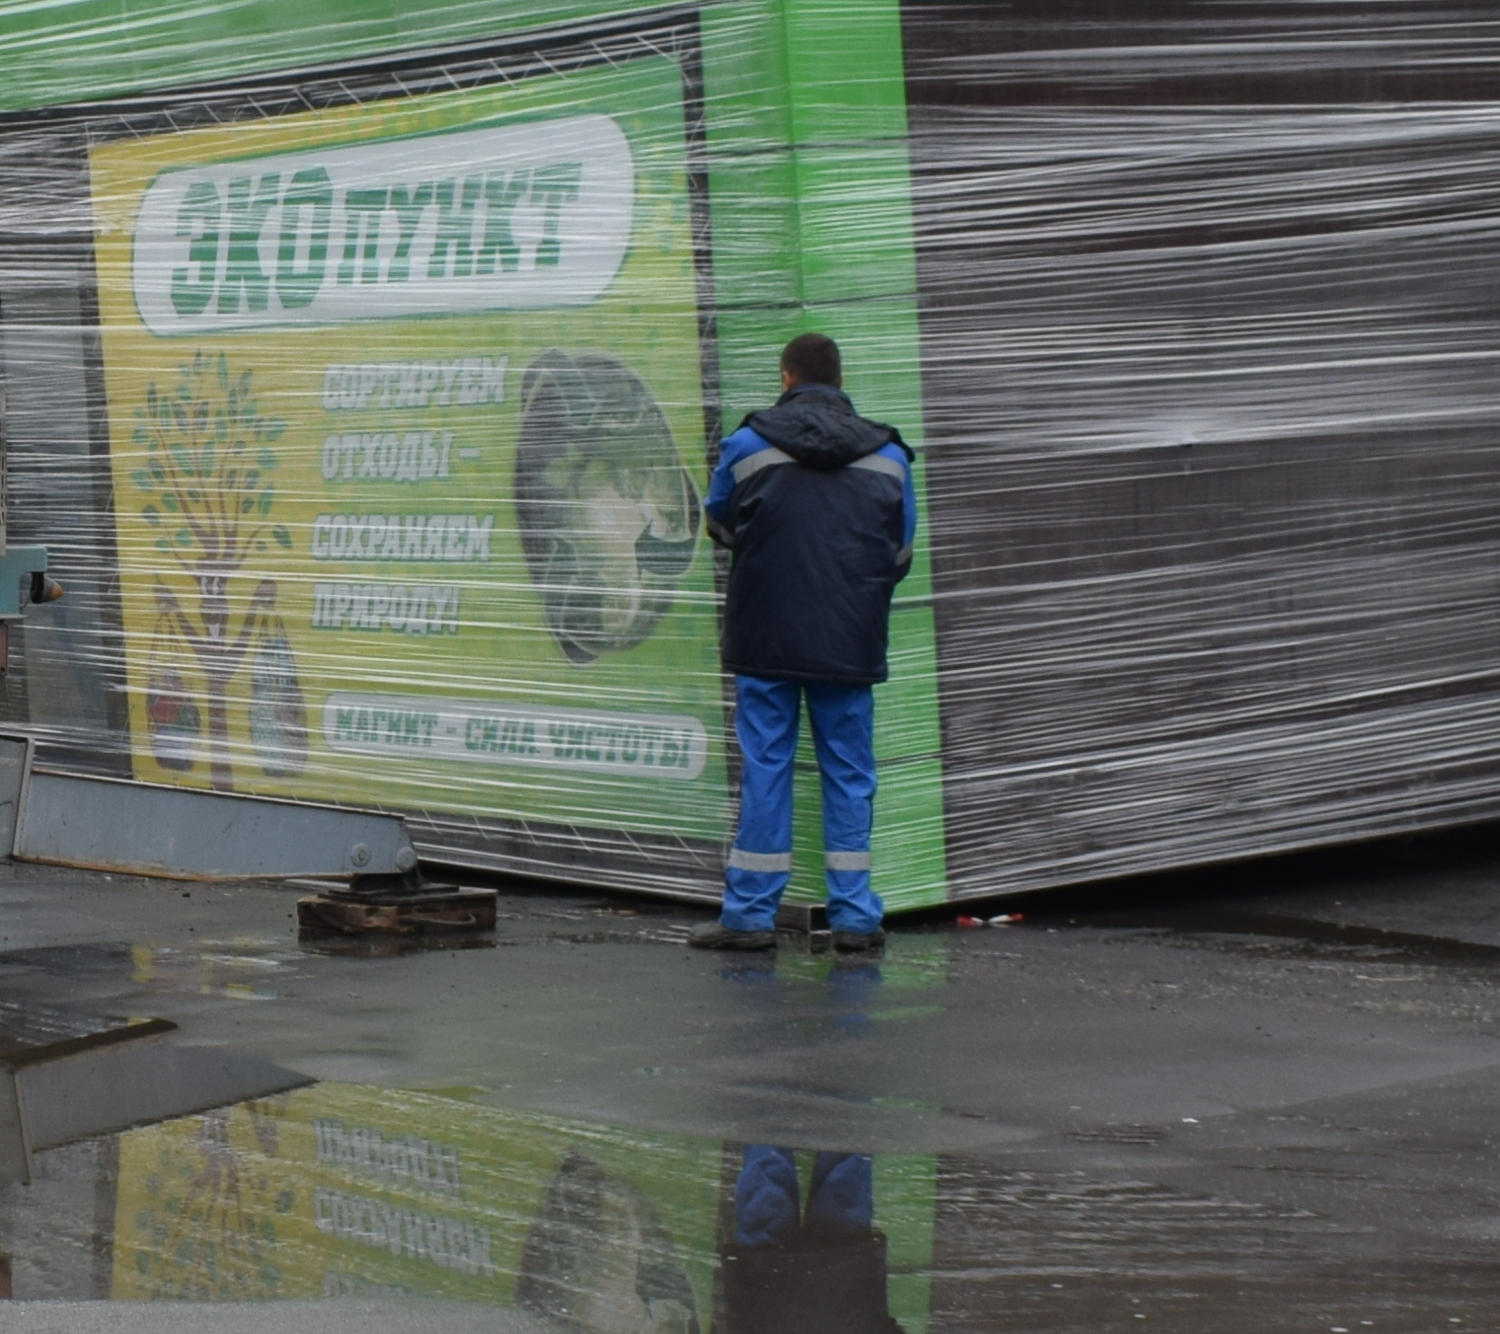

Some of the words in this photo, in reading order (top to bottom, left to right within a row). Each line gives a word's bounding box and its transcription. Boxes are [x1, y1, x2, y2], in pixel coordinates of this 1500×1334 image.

[320, 430, 454, 482] ОТХОДЫ
[311, 513, 495, 562] СОХРАНЯЕМ
[311, 582, 461, 636] ПРИРОДУ!
[333, 706, 439, 748] МАГНИТ
[464, 717, 538, 754] СИЛА
[547, 718, 695, 768] ЧИСТОТЫ
